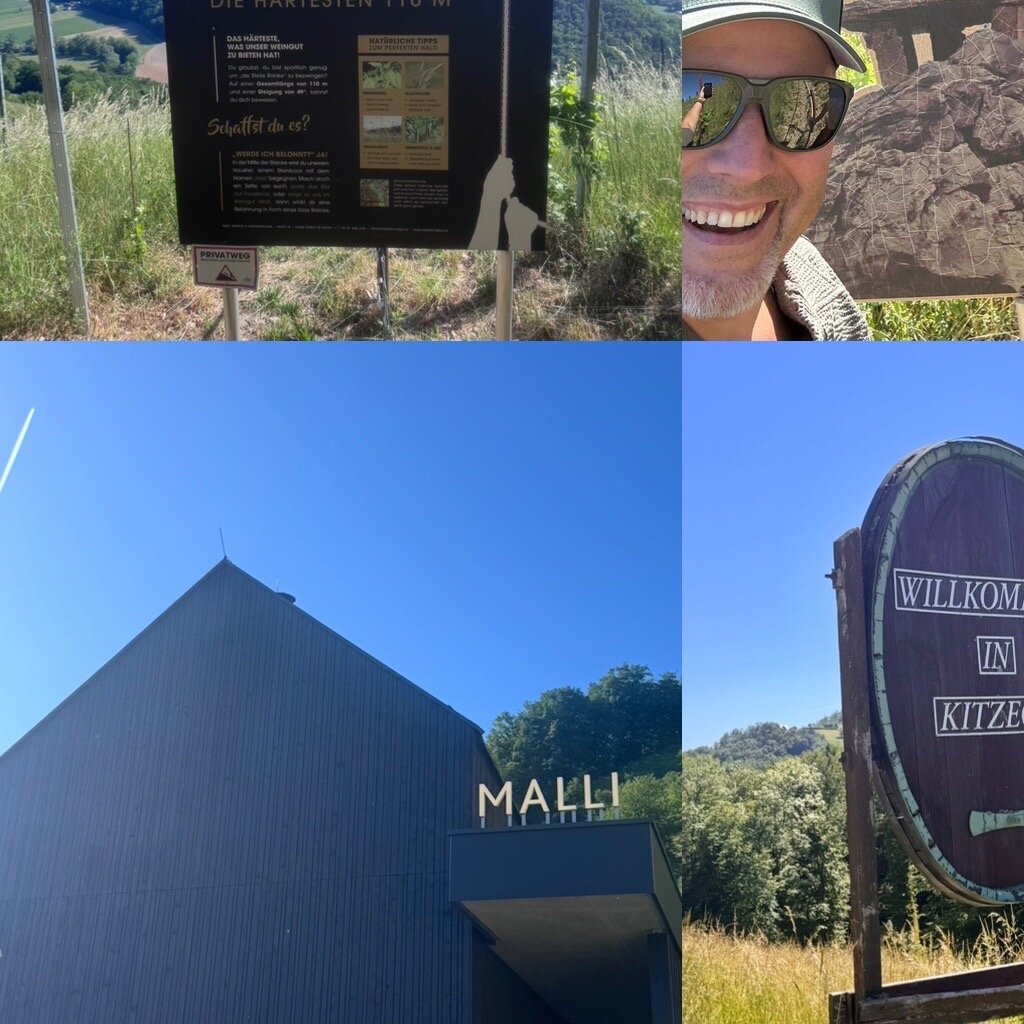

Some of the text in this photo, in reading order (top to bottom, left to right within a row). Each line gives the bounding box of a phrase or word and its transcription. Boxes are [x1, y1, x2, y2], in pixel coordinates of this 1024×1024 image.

[227, 43, 304, 51] WAS UNSER WEINGUT
[207, 114, 311, 137] Schaffst du es?
[200, 251, 251, 260] PRIVATWEG
[982, 640, 1012, 671] IN
[478, 771, 619, 818] MALLI
